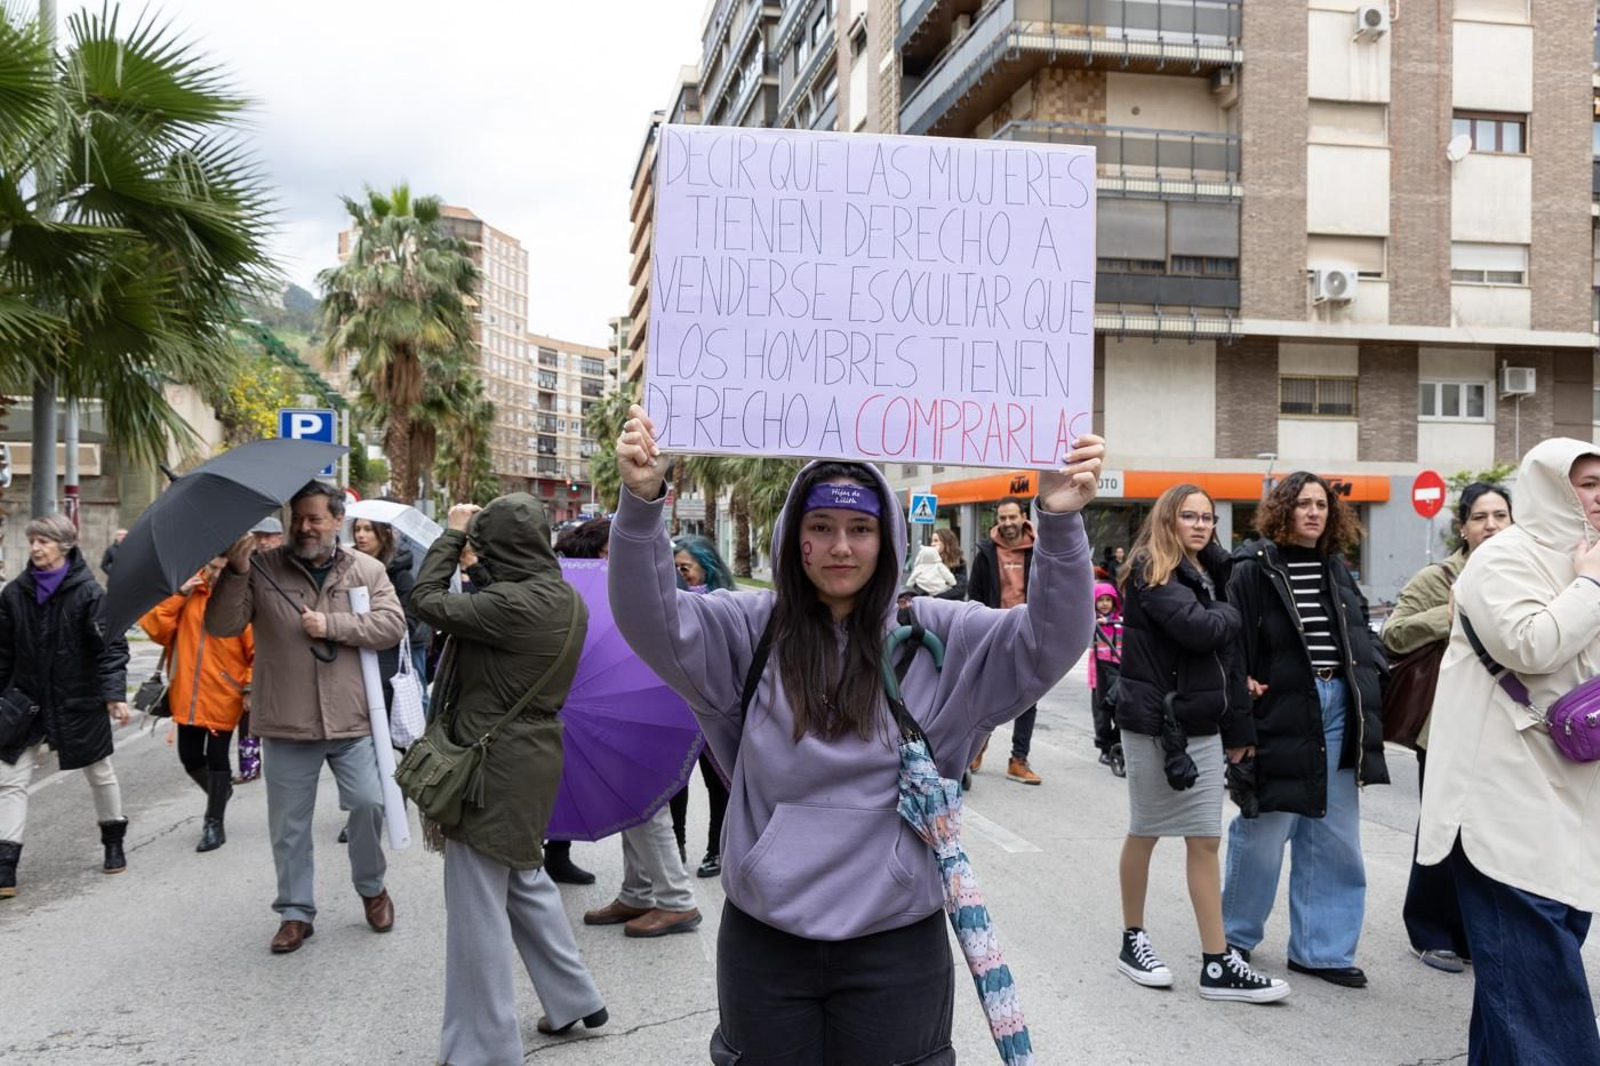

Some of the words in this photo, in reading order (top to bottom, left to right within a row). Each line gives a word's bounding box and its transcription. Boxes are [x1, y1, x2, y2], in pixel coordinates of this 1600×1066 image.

[666, 130, 758, 190] DECIR
[768, 137, 834, 193] QUE
[846, 141, 912, 200] LAS
[928, 146, 1089, 209] MUJERES
[685, 194, 822, 255] TIENEN
[844, 202, 1011, 266] DERECHO
[1031, 217, 1061, 272] A
[655, 255, 837, 321] VENDERSE
[1023, 278, 1091, 336] QUE
[656, 320, 729, 380] LOS
[743, 328, 918, 389] HOMBRES
[930, 336, 1071, 398] TIENEN
[291, 414, 323, 440] P
[647, 382, 810, 449] DERECHO
[818, 395, 844, 454] A
[831, 488, 850, 498] Hijas
[851, 489, 861, 497] de
[1009, 475, 1030, 495] KTM
